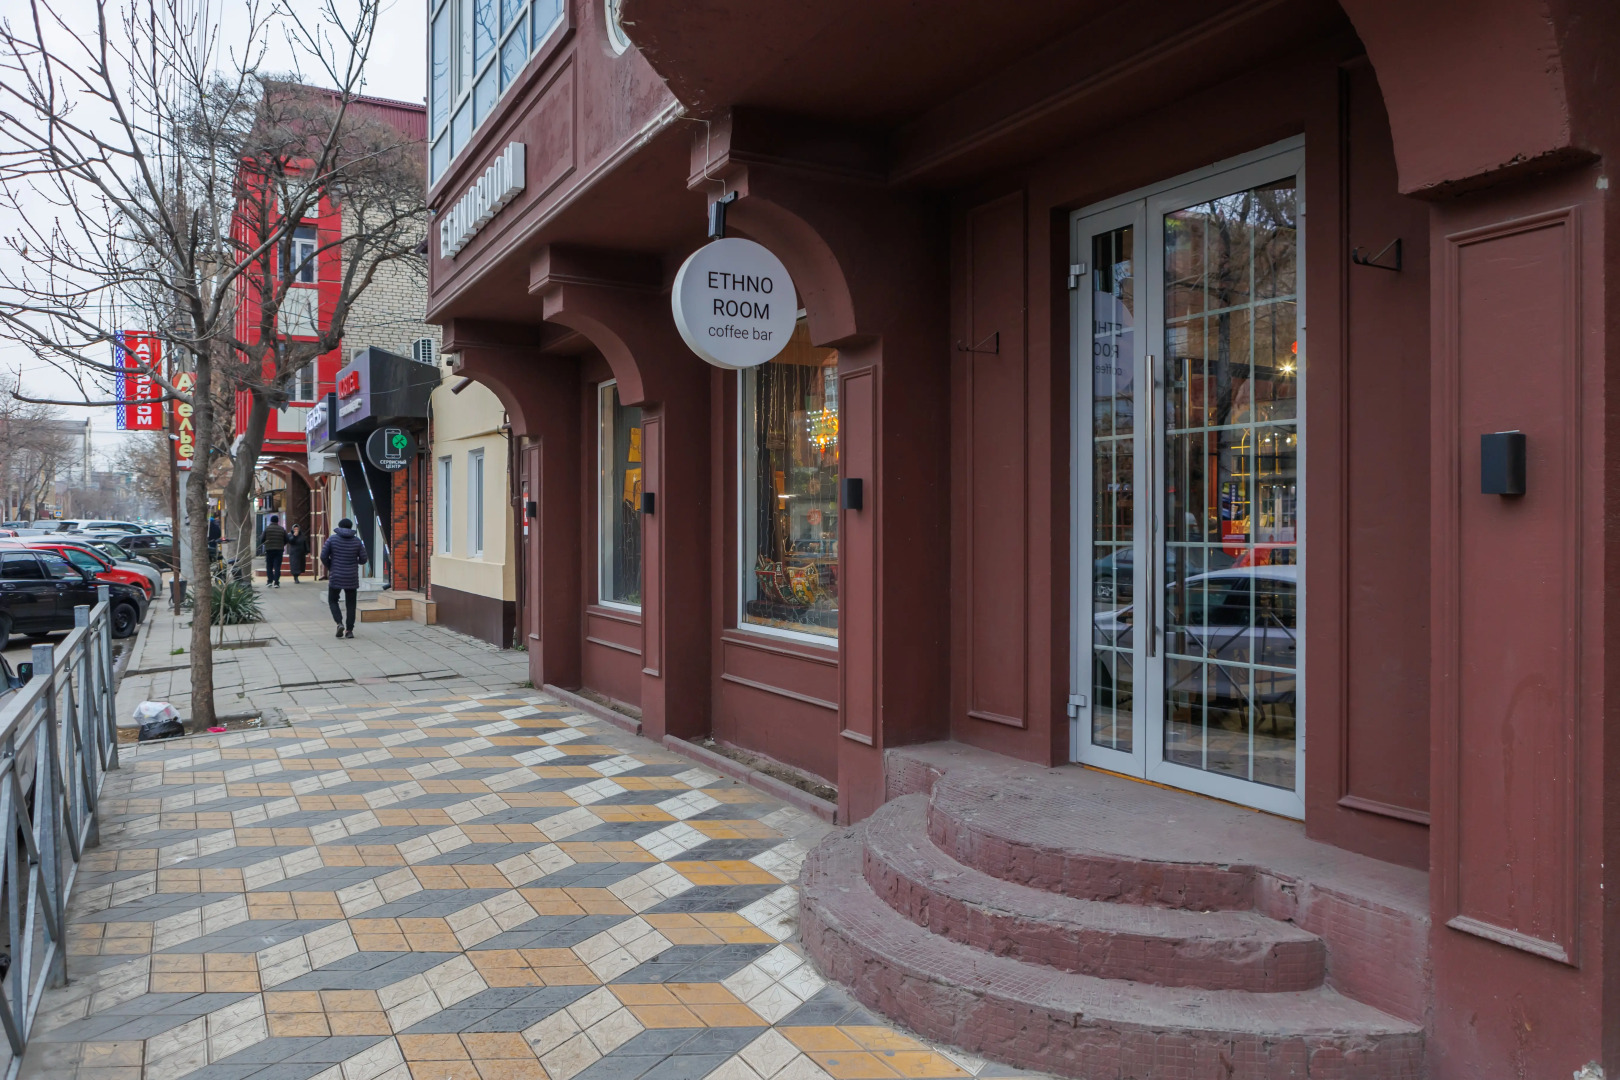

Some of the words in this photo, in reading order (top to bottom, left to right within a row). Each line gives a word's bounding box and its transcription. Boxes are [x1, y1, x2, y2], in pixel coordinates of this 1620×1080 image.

[708, 271, 774, 294] ETHNO
[713, 298, 770, 320] ROOM
[708, 324, 749, 339] coffee
[752, 327, 773, 341] bar
[135, 333, 153, 425] ГАСРОНОМ
